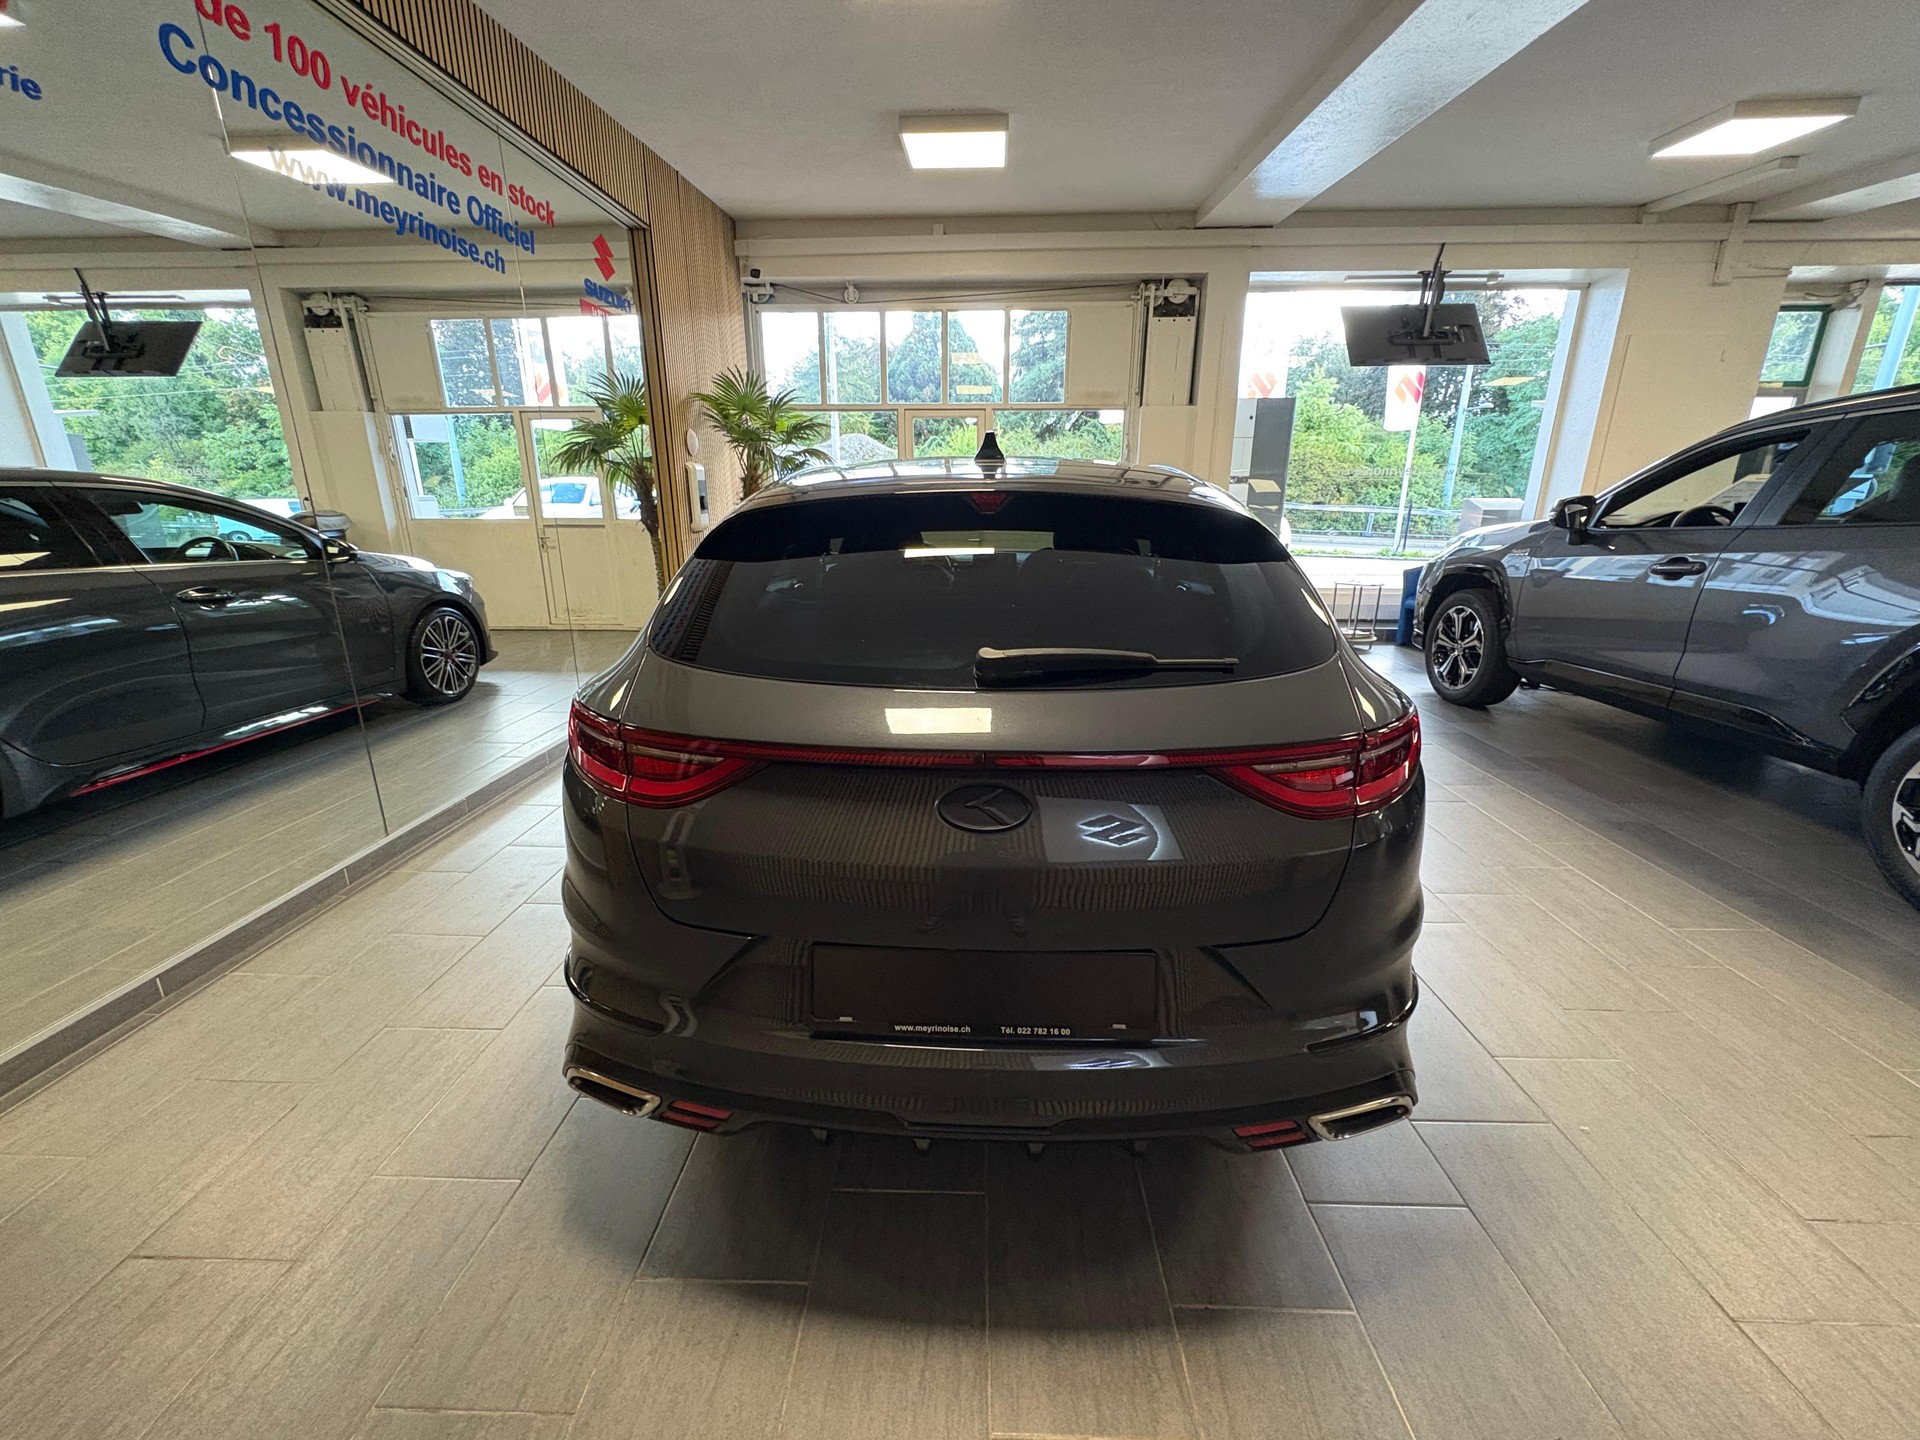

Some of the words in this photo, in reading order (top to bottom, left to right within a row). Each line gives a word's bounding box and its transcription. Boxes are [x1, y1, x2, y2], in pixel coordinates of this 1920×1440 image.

[158, 22, 461, 216] Concessionnaire
[466, 205, 536, 255] Officiel
[264, 22, 331, 90] 100
[340, 75, 472, 177] véhicules
[478, 164, 503, 196] en
[508, 183, 556, 228] stock
[267, 145, 506, 275] www.meyrinoise.ch
[583, 278, 632, 314] SUZUKI
[894, 1024, 972, 1034] www.meyrinoise.ch
[1017, 1026, 1032, 1035] 022
[1033, 1027, 1048, 1036] 782
[1049, 1027, 1059, 1036] 16
[1060, 1028, 1071, 1036] 00
